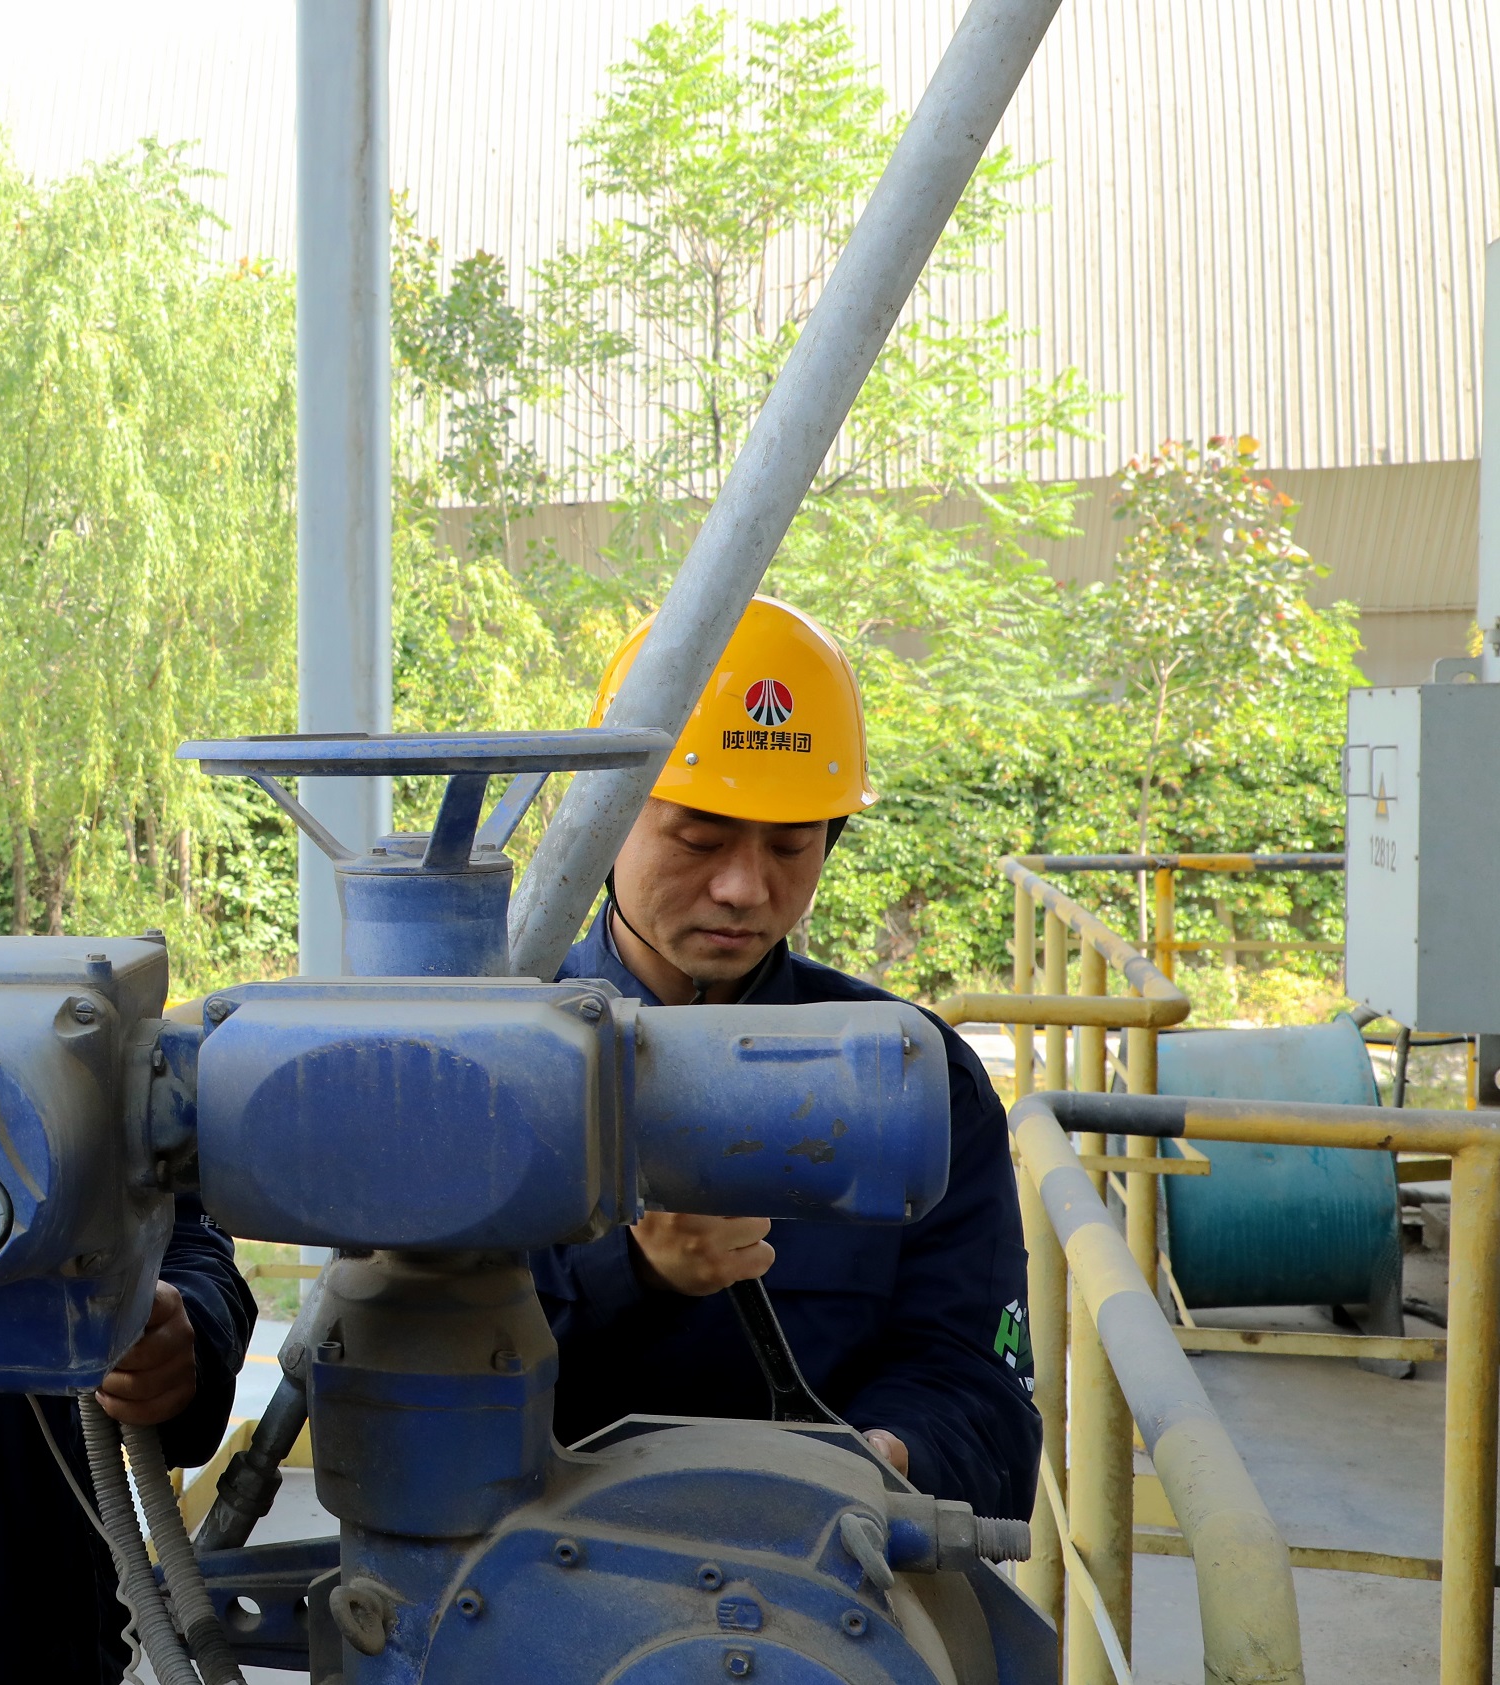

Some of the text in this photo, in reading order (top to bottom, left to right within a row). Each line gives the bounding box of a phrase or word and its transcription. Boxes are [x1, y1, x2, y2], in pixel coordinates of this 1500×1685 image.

[722, 730, 812, 753] 陕煤集团
[1369, 833, 1397, 873] 12812
